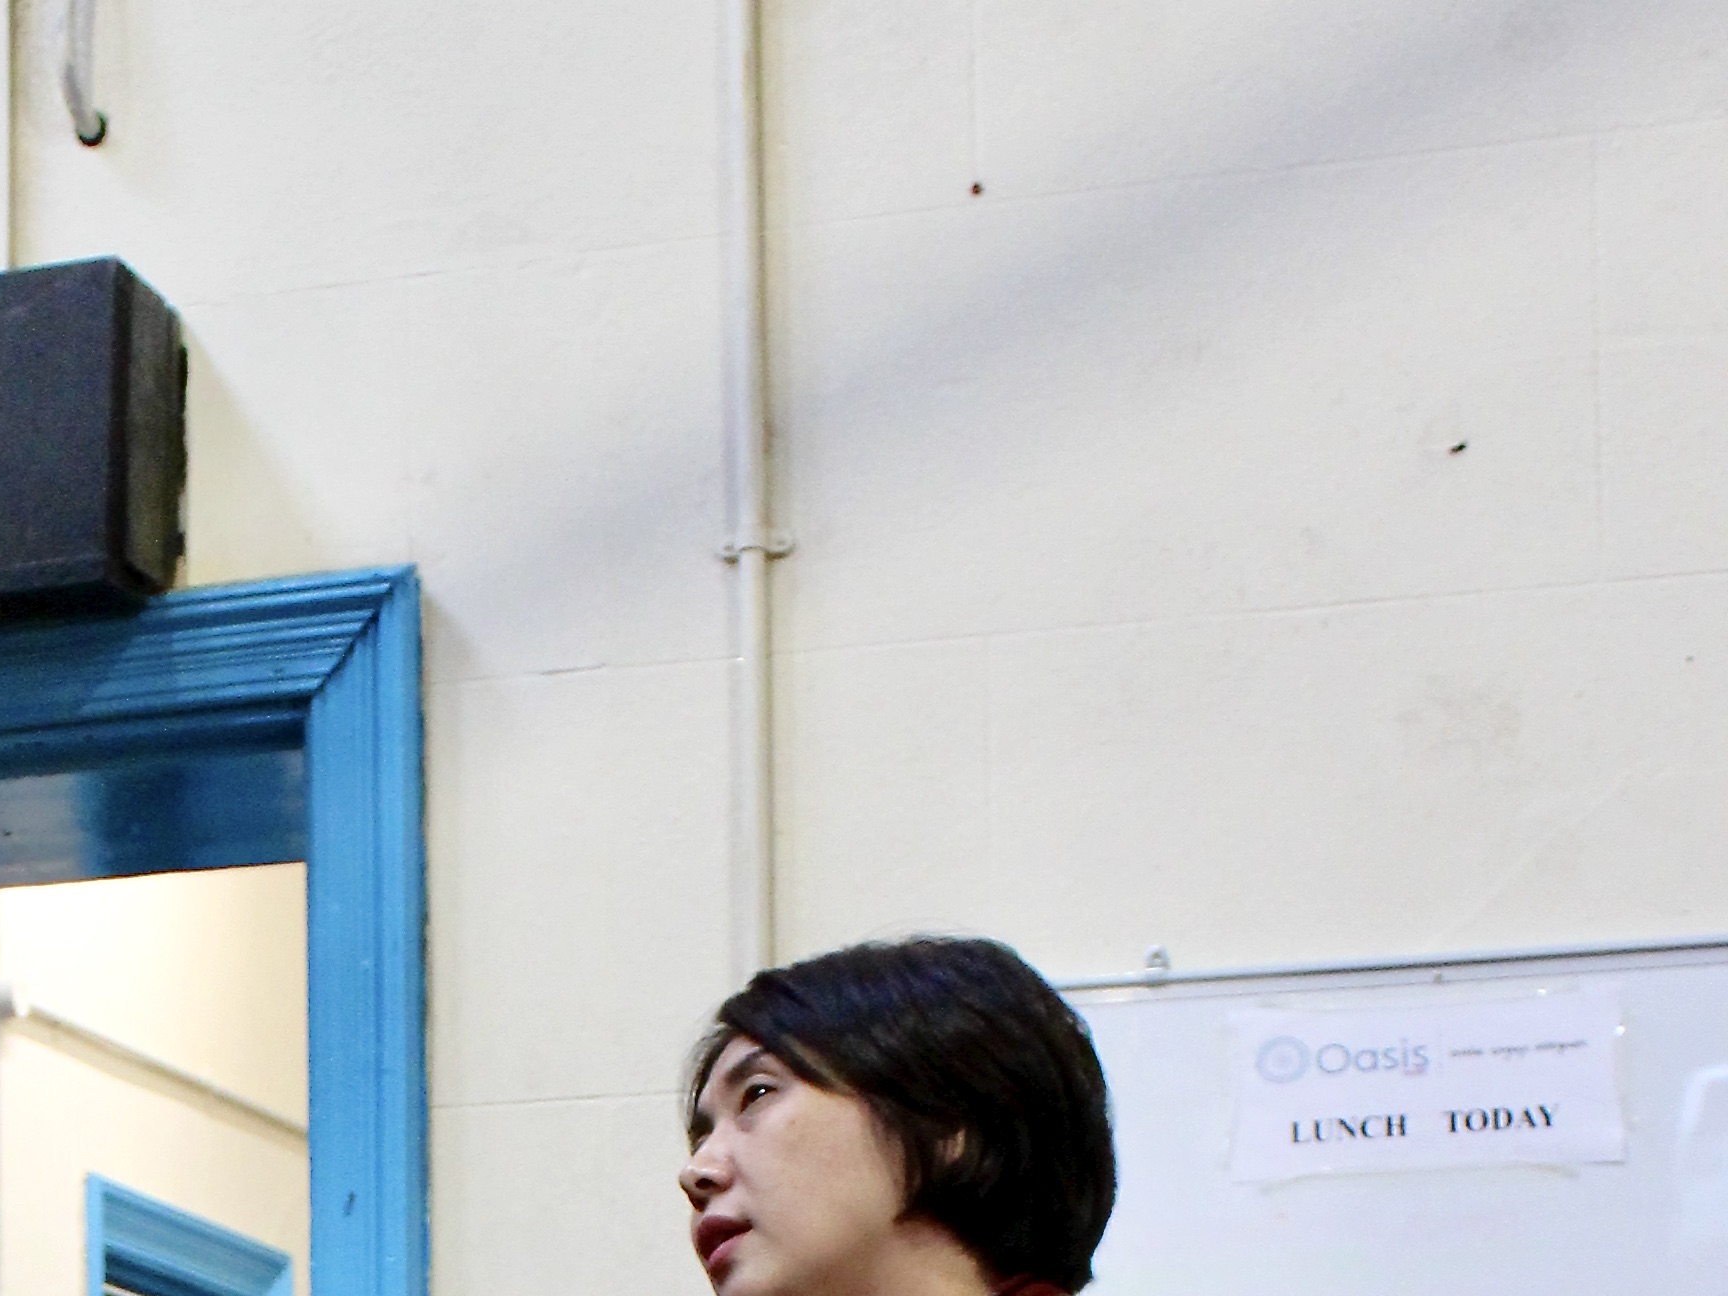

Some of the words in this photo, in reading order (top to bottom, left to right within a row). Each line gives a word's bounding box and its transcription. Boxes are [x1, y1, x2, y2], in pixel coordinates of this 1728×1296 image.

[1315, 1036, 1431, 1075] Oasis
[1290, 1111, 1409, 1144] LUNCH
[1439, 1103, 1560, 1134] TODAY
